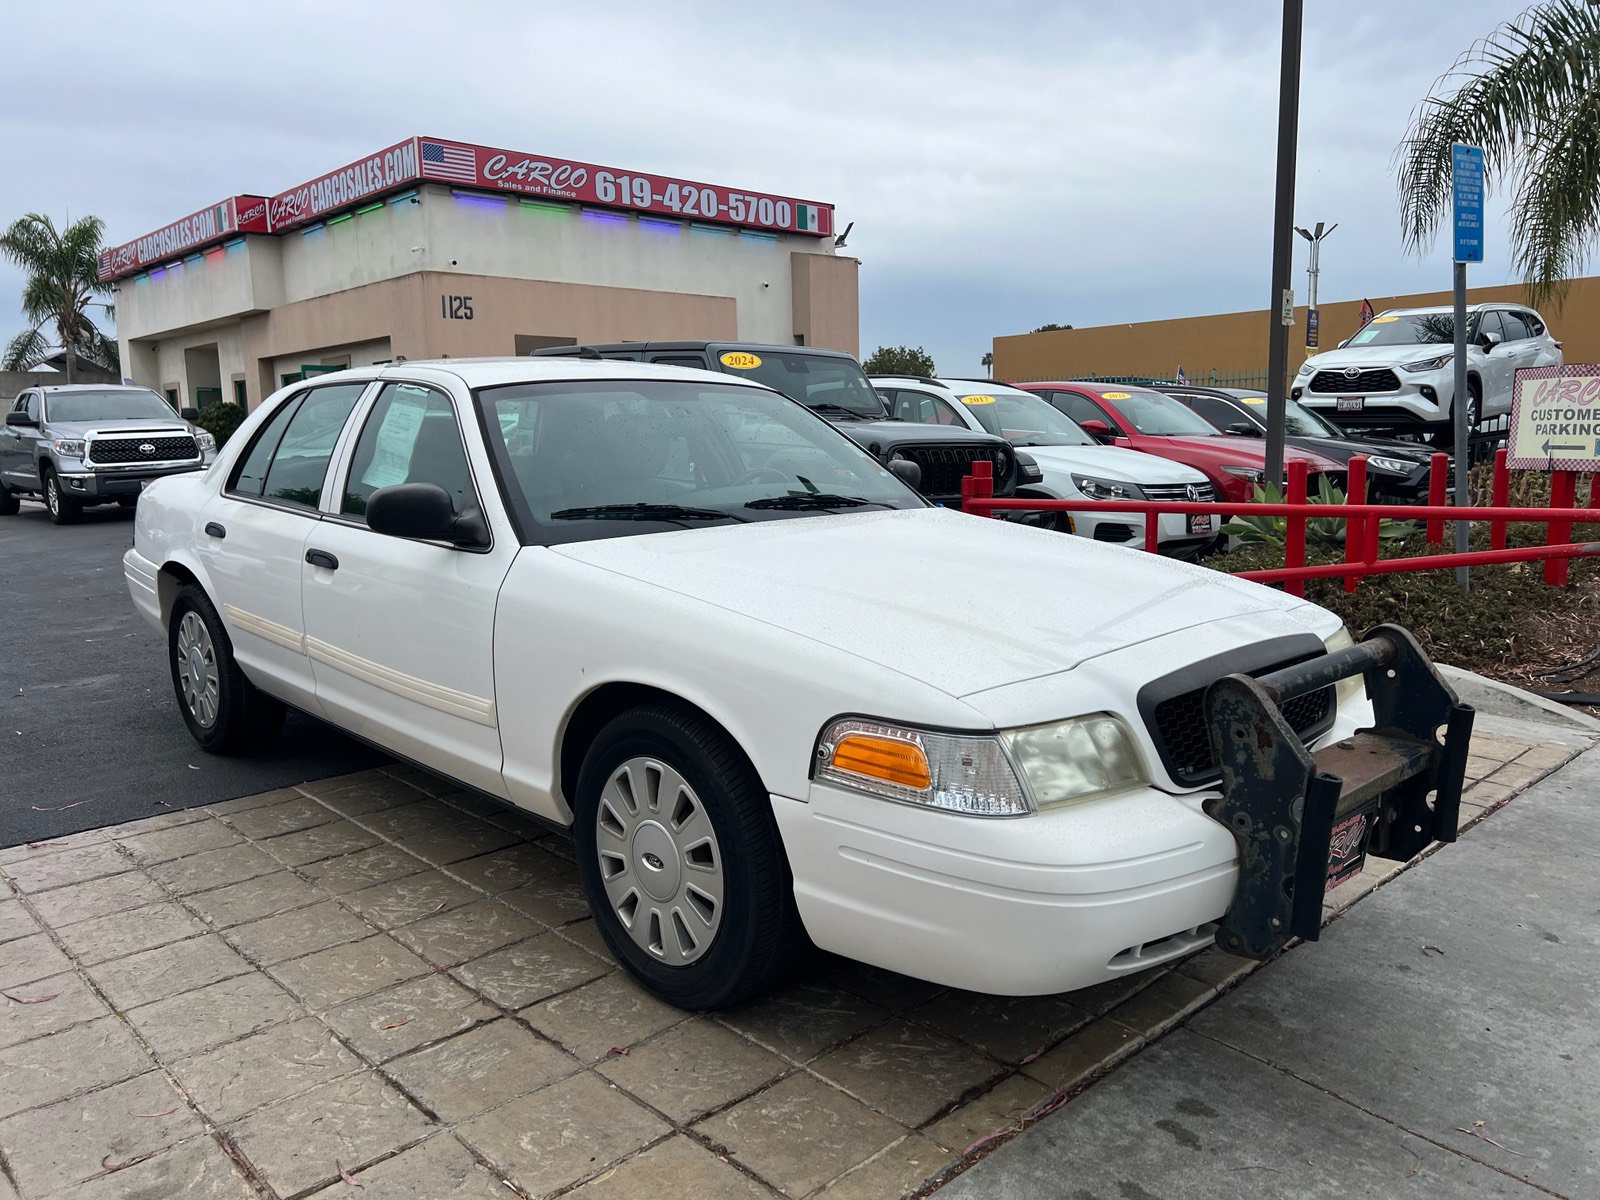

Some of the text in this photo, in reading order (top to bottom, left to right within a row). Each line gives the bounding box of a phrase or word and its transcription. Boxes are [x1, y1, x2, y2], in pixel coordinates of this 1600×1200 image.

[310, 143, 415, 214] CARCOSALES.COM
[483, 154, 792, 228] CARCO 619-420-5700
[497, 180, 522, 190] Sales
[543, 186, 577, 198] Finance
[237, 203, 265, 225] CARCO
[271, 187, 309, 225] CARCO
[111, 208, 216, 271] CARCO CARCOSALES.COM
[441, 294, 474, 320] 1125
[728, 355, 755, 366] 2024
[967, 396, 989, 404] 2017
[1532, 378, 1600, 408] CARC
[1535, 423, 1600, 436] PARKING
